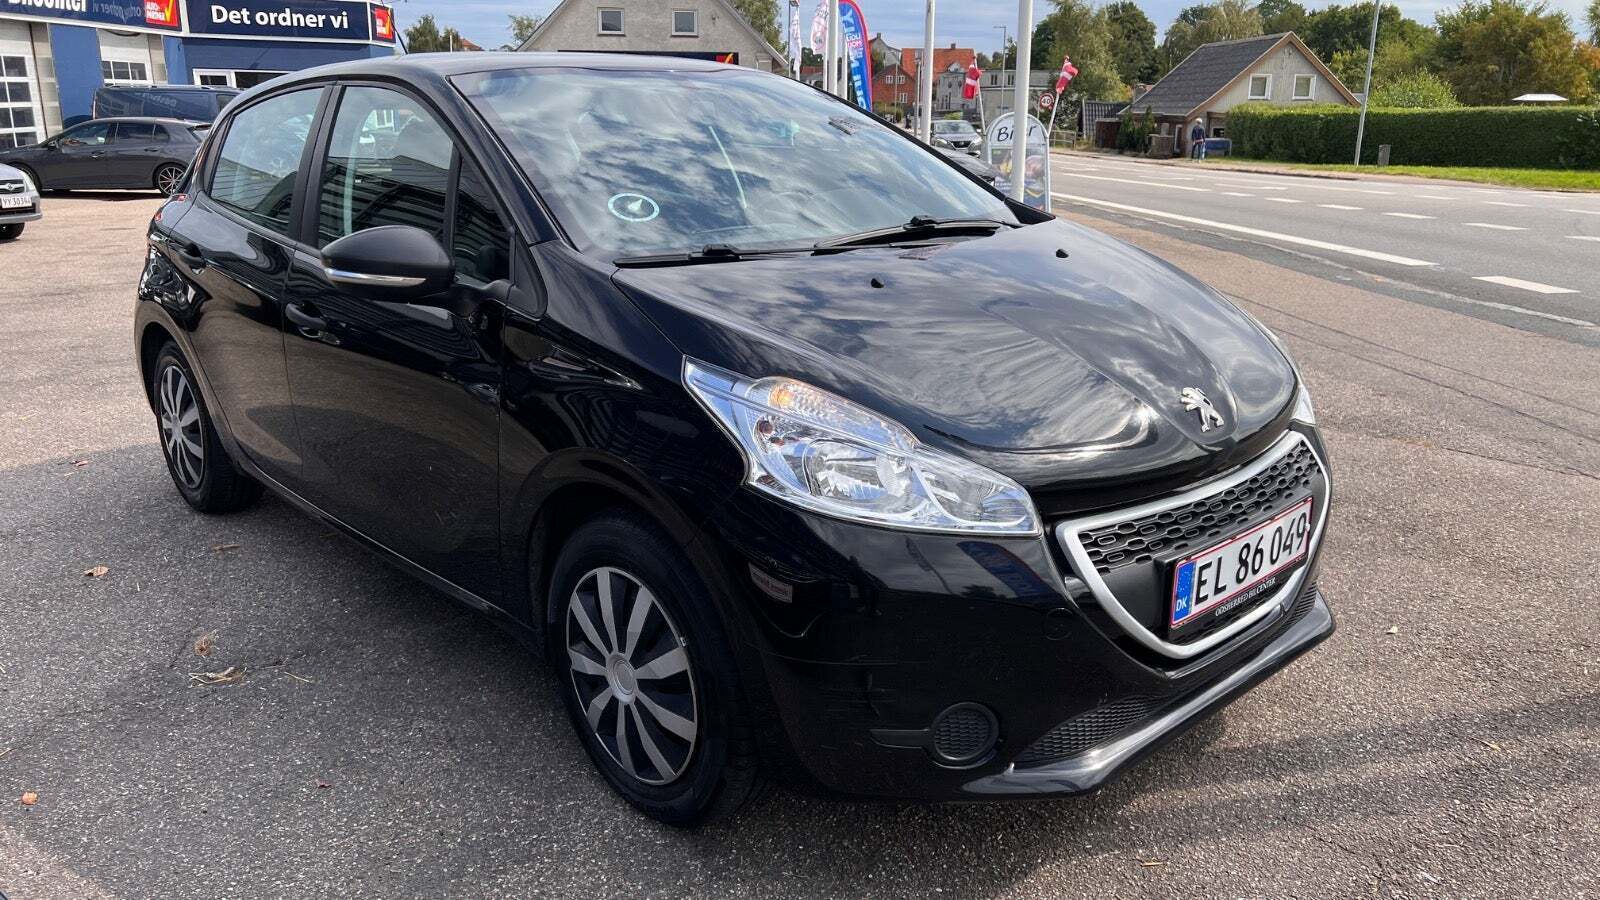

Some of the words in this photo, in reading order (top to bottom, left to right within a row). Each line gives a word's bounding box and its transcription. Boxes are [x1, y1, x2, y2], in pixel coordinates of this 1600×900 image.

[211, 5, 251, 24] Det
[255, 7, 327, 28] ordner
[329, 11, 348, 28] vi
[998, 124, 1037, 142] Bir
[1194, 556, 1227, 606] EL
[1235, 534, 1264, 584] 86
[1270, 512, 1307, 566] 049
[1256, 577, 1276, 594] CENTER
[1175, 596, 1188, 612] DK
